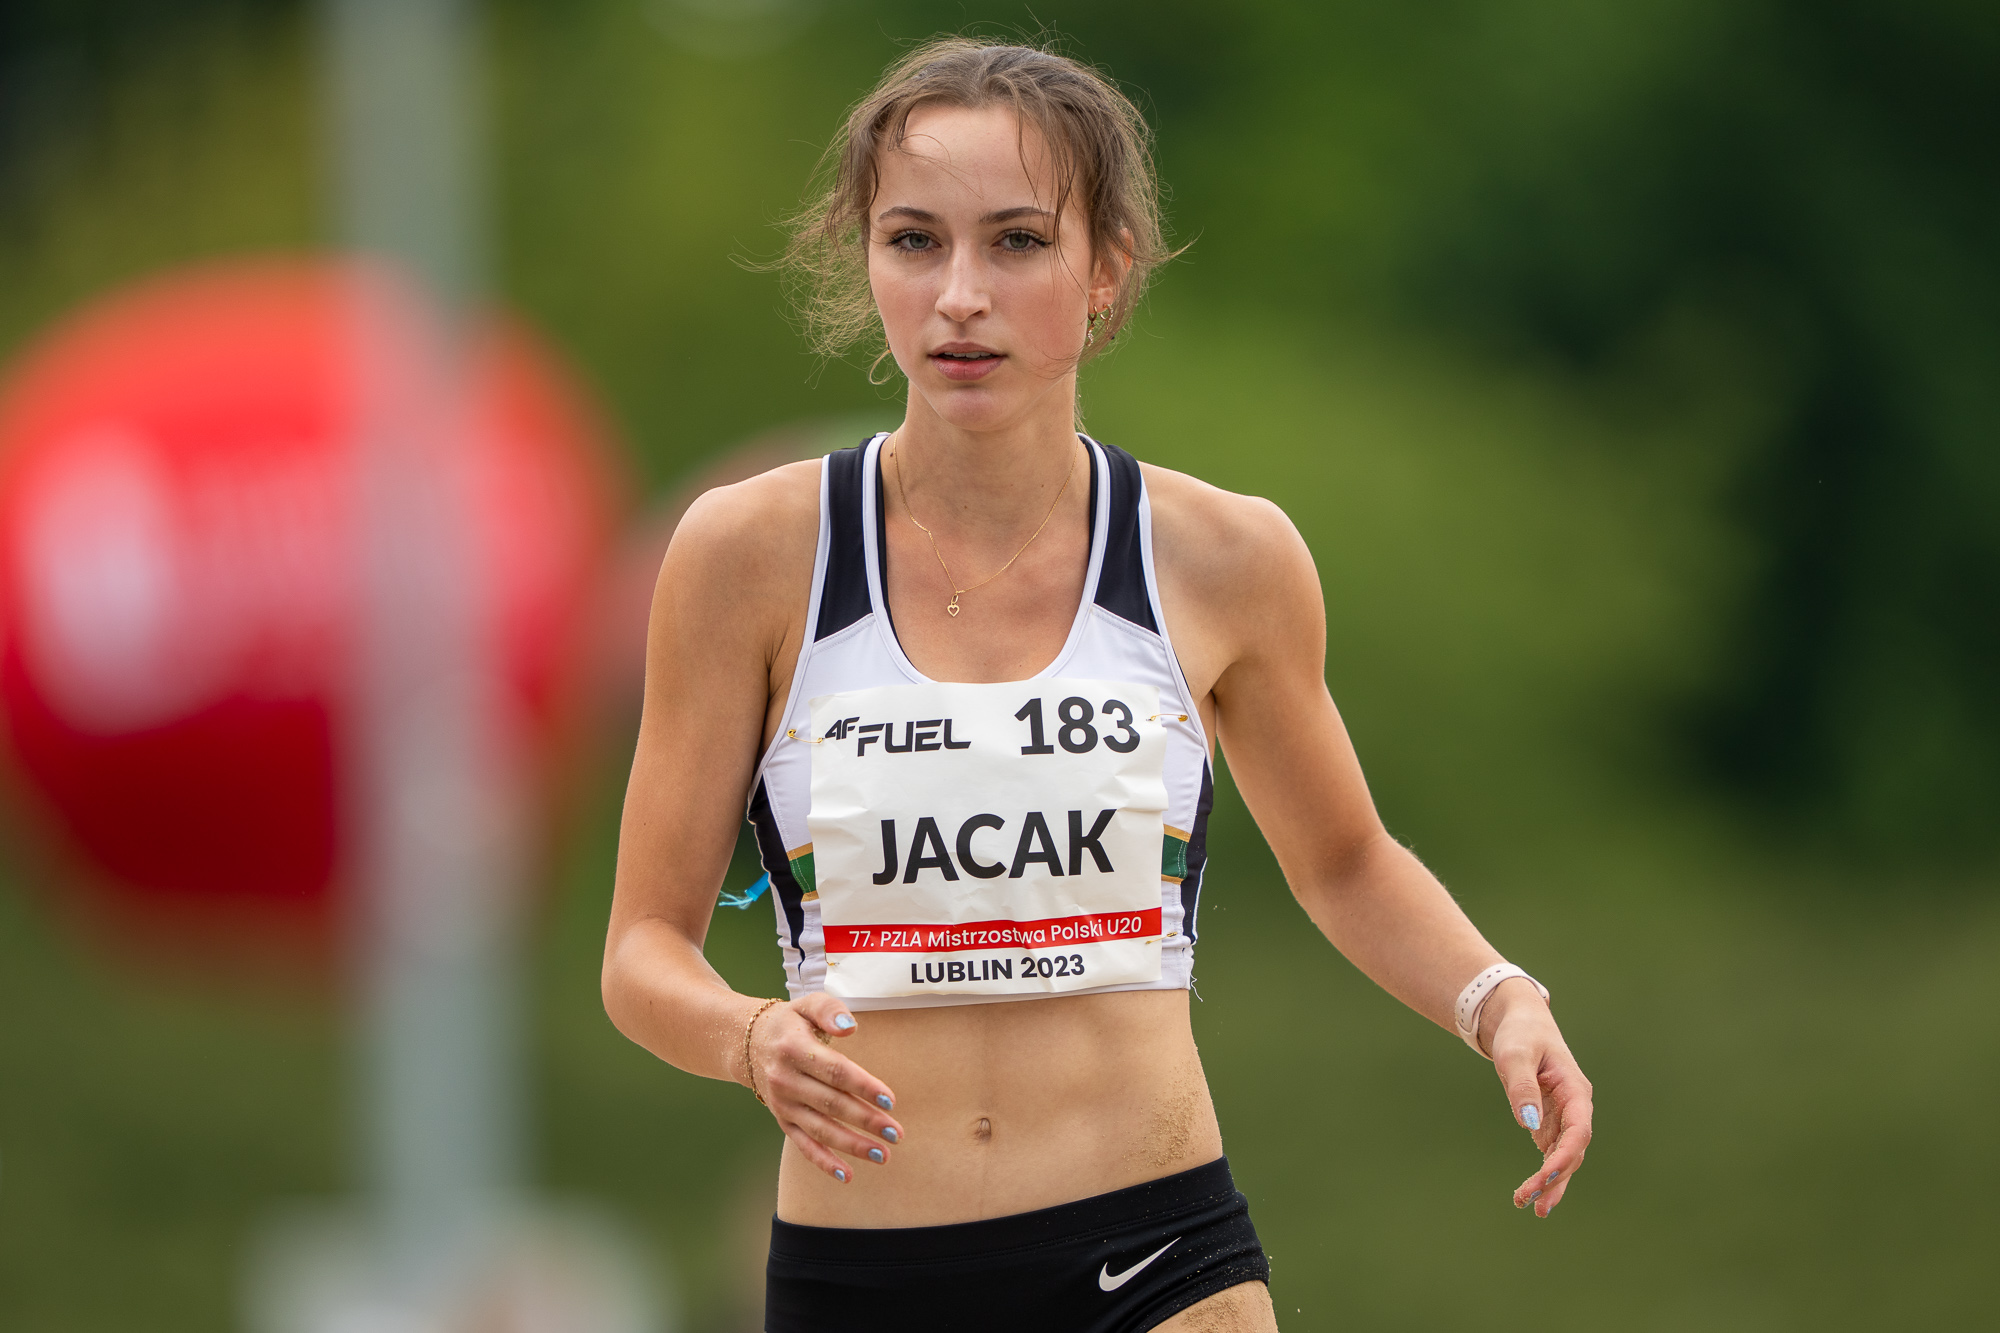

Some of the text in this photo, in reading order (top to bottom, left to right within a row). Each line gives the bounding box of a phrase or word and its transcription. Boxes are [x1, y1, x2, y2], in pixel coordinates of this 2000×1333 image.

[857, 718, 971, 757] FUEL
[1014, 696, 1141, 756] 183
[872, 808, 1117, 885] JACAK
[849, 917, 1142, 948] 77. PZLA Mistrzostwa Polski U20
[911, 954, 1085, 984] LUBLIN 2023
